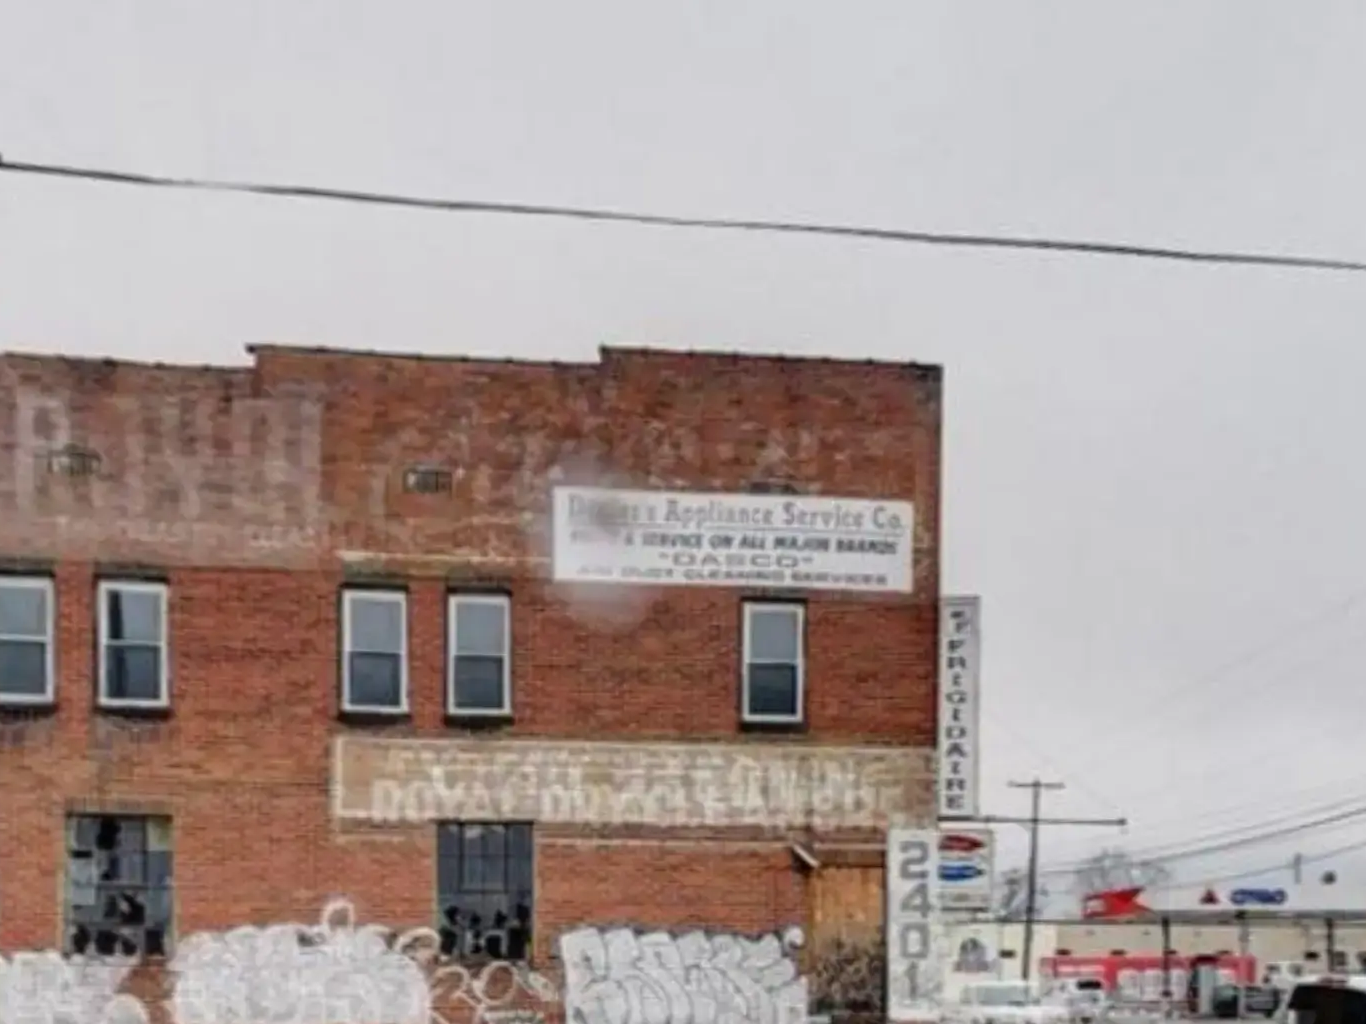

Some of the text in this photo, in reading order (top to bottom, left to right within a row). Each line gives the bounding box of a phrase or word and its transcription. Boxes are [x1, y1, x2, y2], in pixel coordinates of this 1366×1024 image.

[664, 499, 773, 528] Appliance
[782, 502, 864, 527] Service
[738, 534, 766, 550] ALL
[898, 841, 931, 1000] 2401
